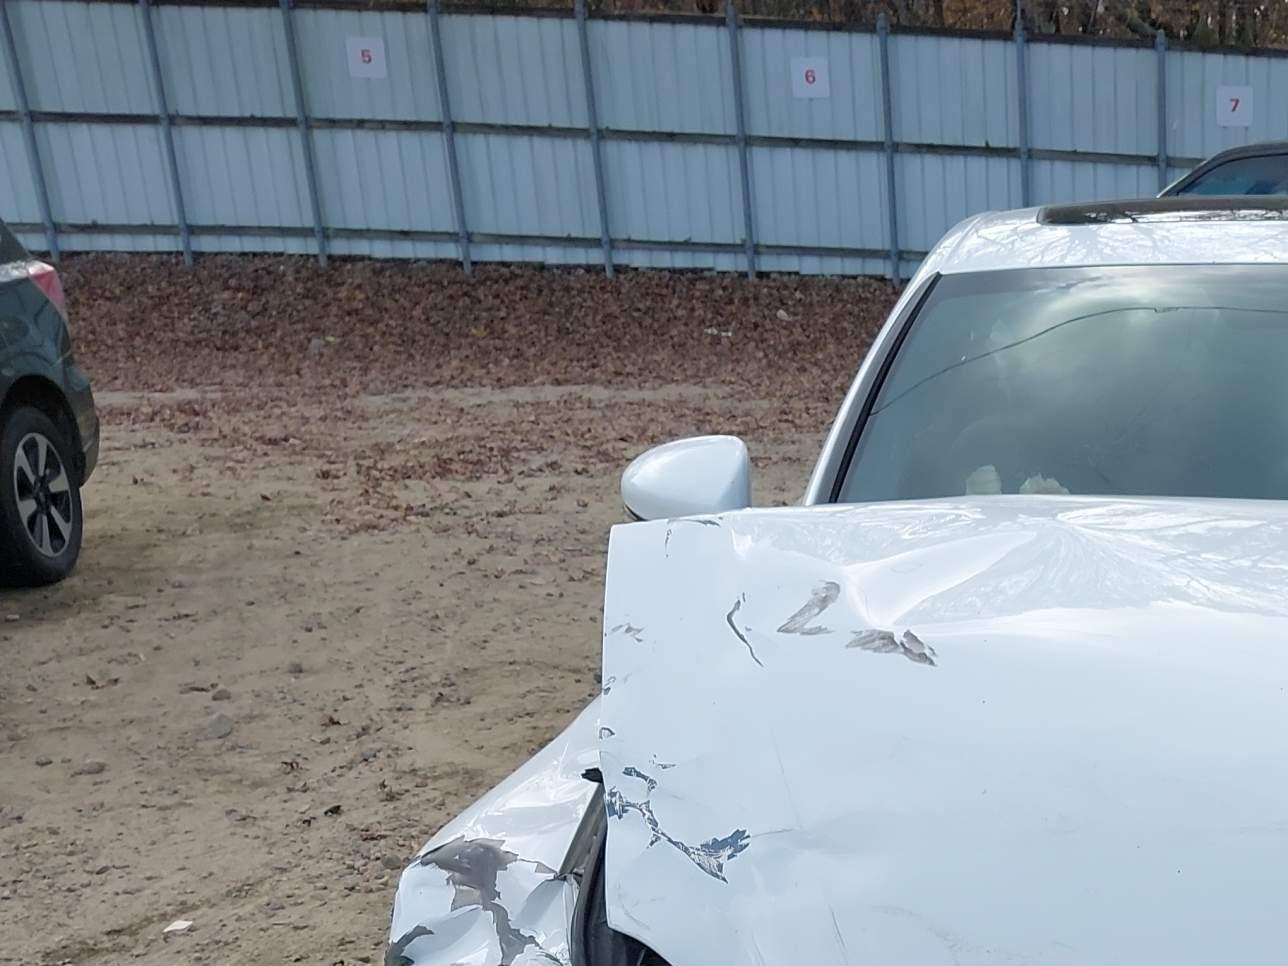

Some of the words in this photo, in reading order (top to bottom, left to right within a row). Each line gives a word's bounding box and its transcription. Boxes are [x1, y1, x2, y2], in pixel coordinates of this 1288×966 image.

[361, 49, 372, 64] 5
[804, 69, 816, 85] 6
[1229, 98, 1240, 112] 7
